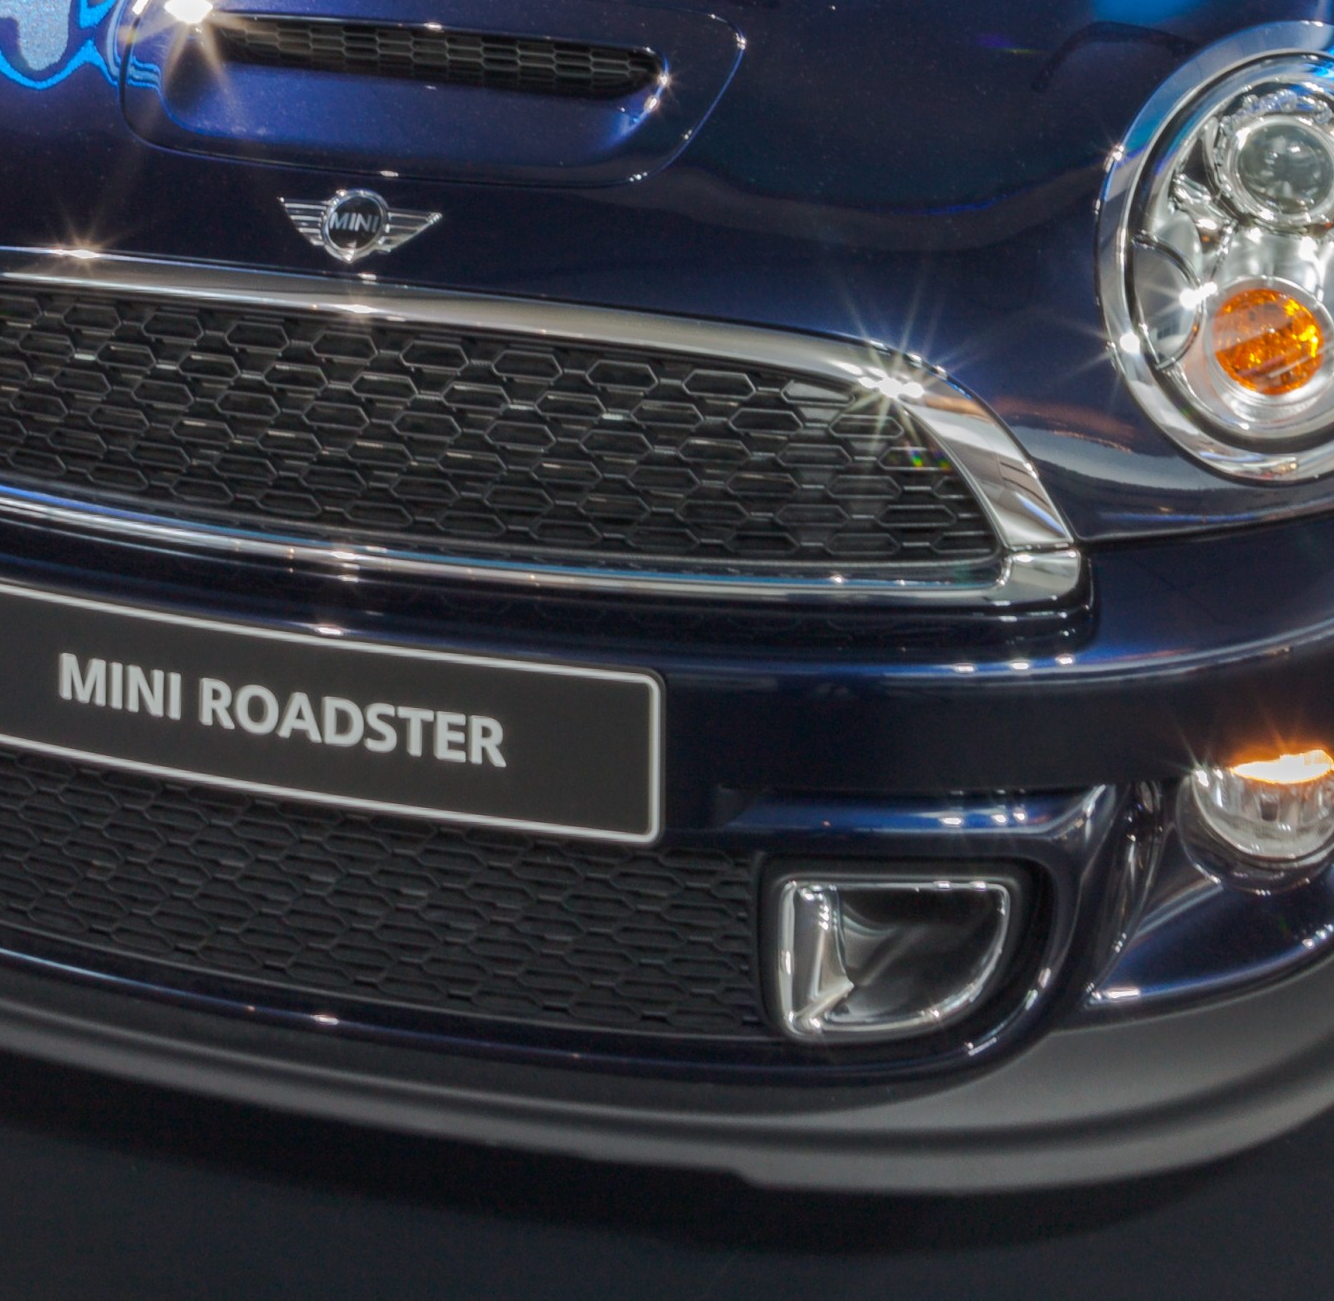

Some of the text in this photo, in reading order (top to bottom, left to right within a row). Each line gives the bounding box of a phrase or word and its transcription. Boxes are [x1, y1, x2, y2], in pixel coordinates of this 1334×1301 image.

[329, 211, 380, 233] MINI
[58, 652, 508, 768] MINI ROADSTER
